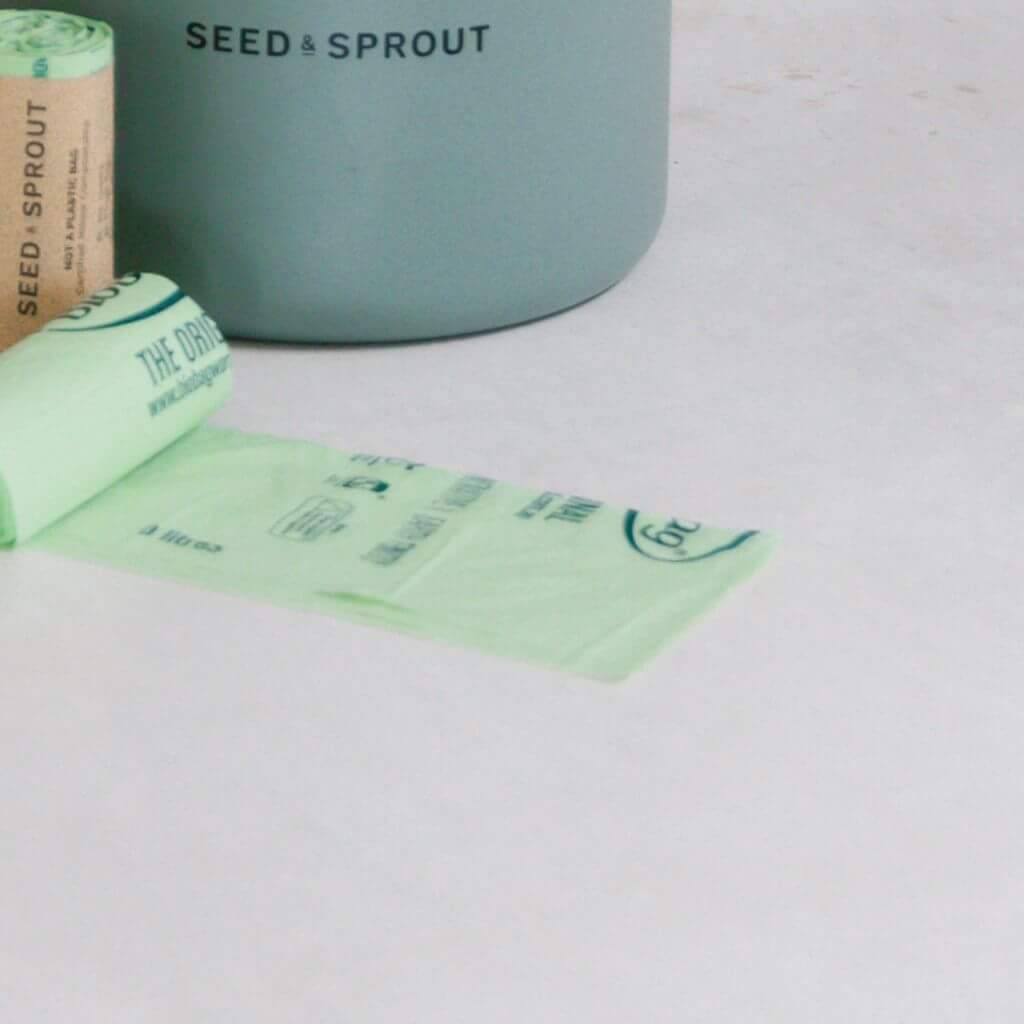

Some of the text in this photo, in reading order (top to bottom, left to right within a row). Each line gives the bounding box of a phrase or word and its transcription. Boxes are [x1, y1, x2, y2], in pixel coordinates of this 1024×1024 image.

[186, 22, 491, 59] SEED & SPROUT
[22, 99, 47, 217] SPROUT
[17, 241, 40, 317] SEED
[64, 245, 74, 270] NOT
[135, 337, 182, 386] THE
